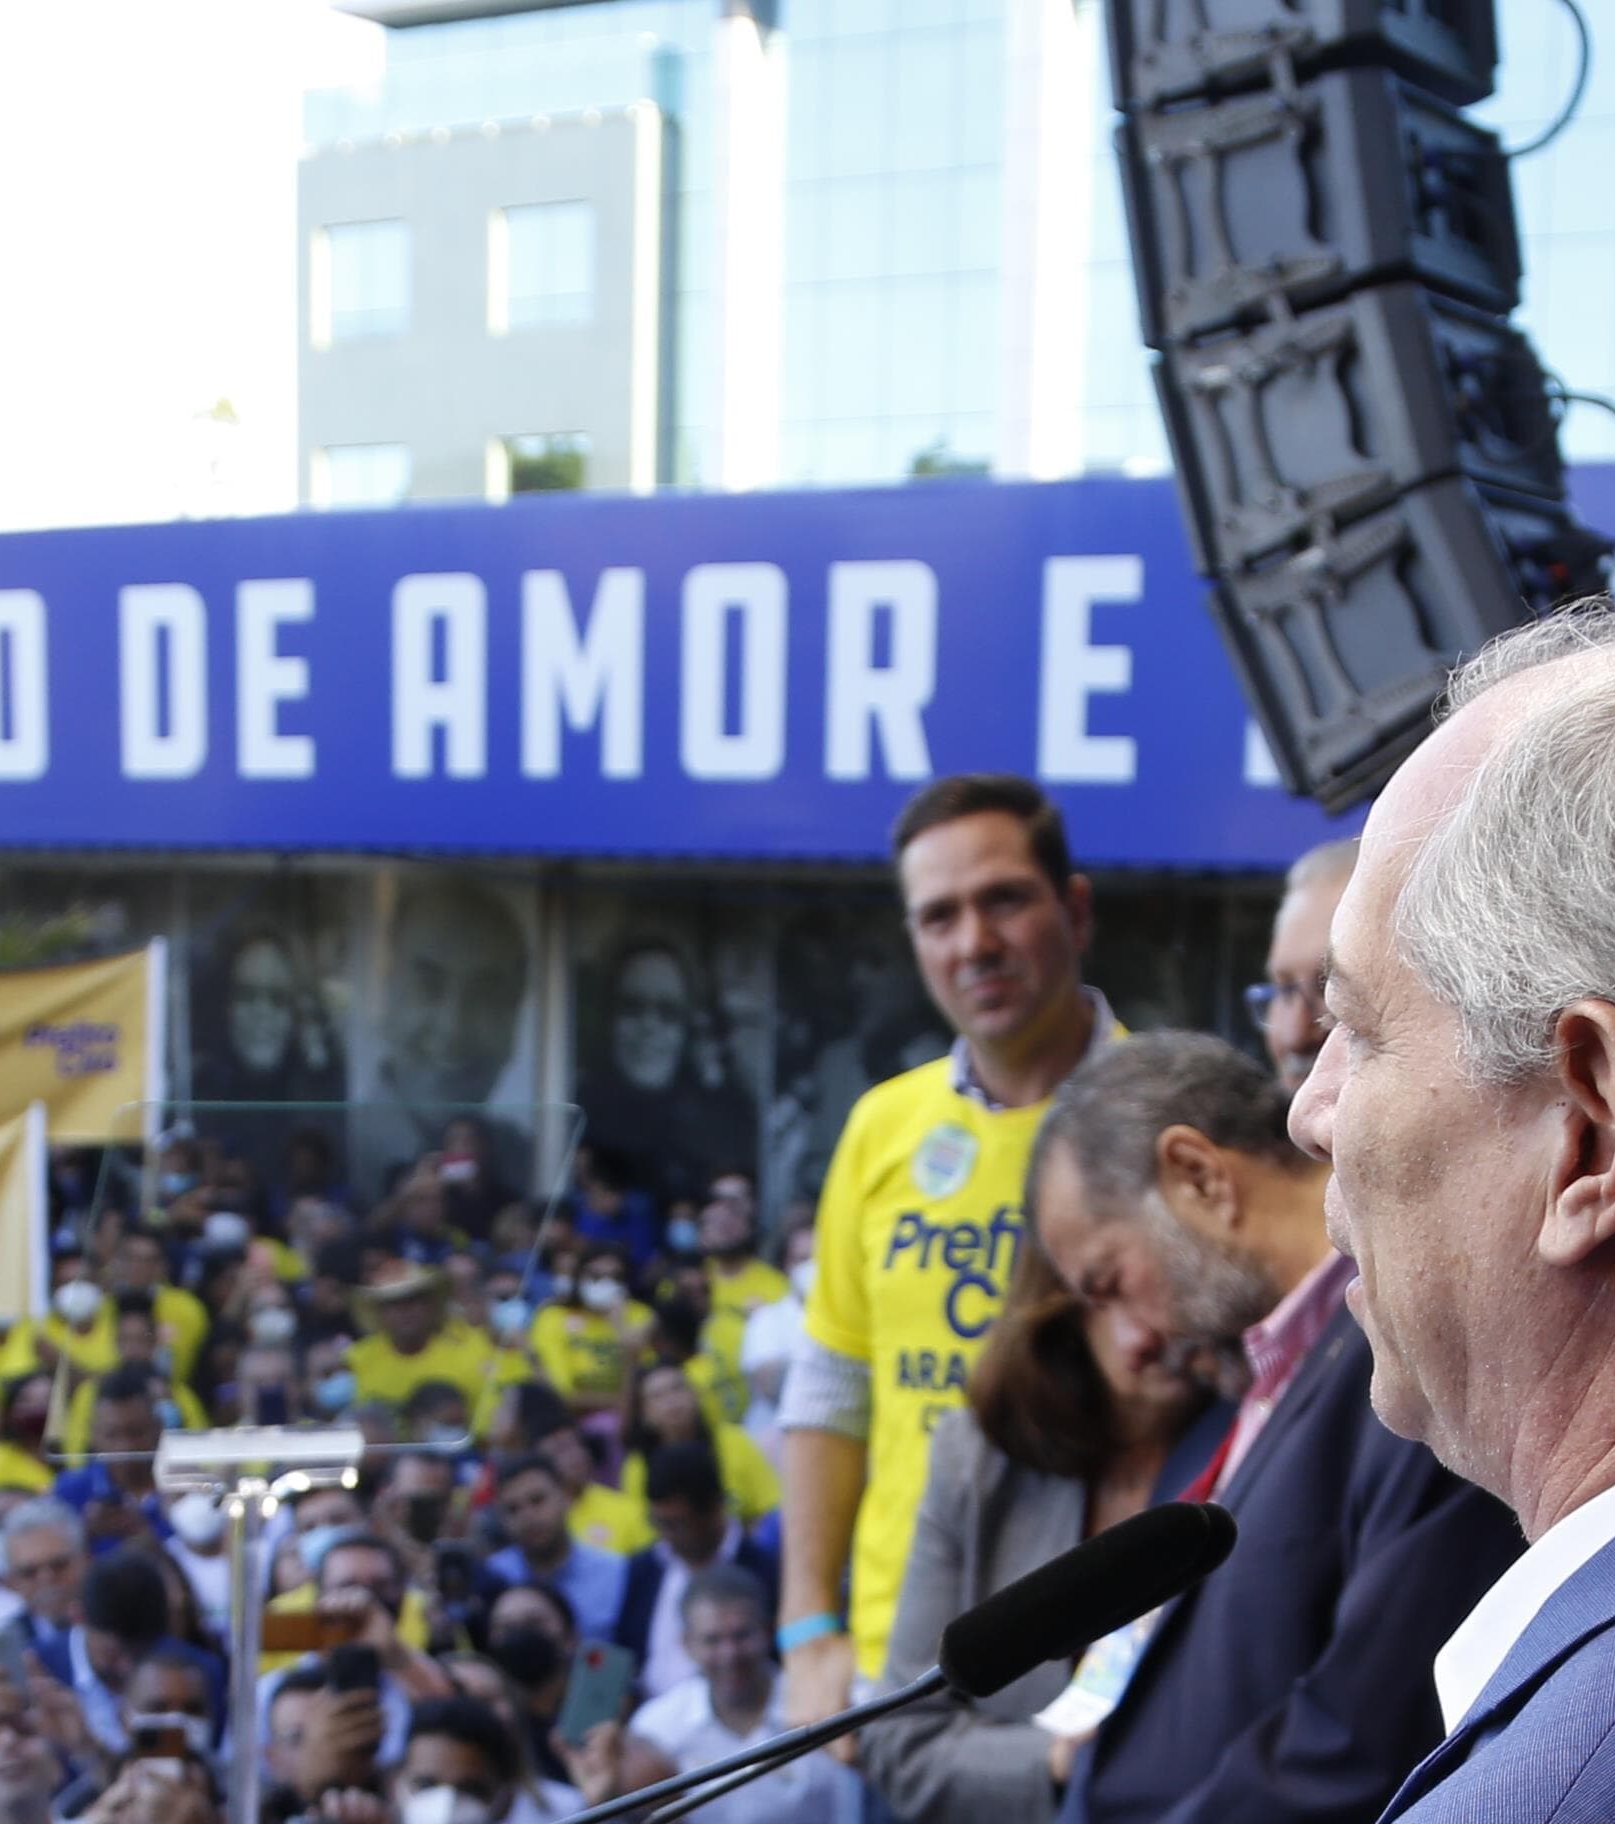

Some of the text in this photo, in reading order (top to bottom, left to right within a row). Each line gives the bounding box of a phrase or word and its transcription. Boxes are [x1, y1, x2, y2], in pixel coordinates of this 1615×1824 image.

[118, 576, 317, 782] DE
[389, 560, 940, 784] AMOR
[1035, 553, 1145, 784] E
